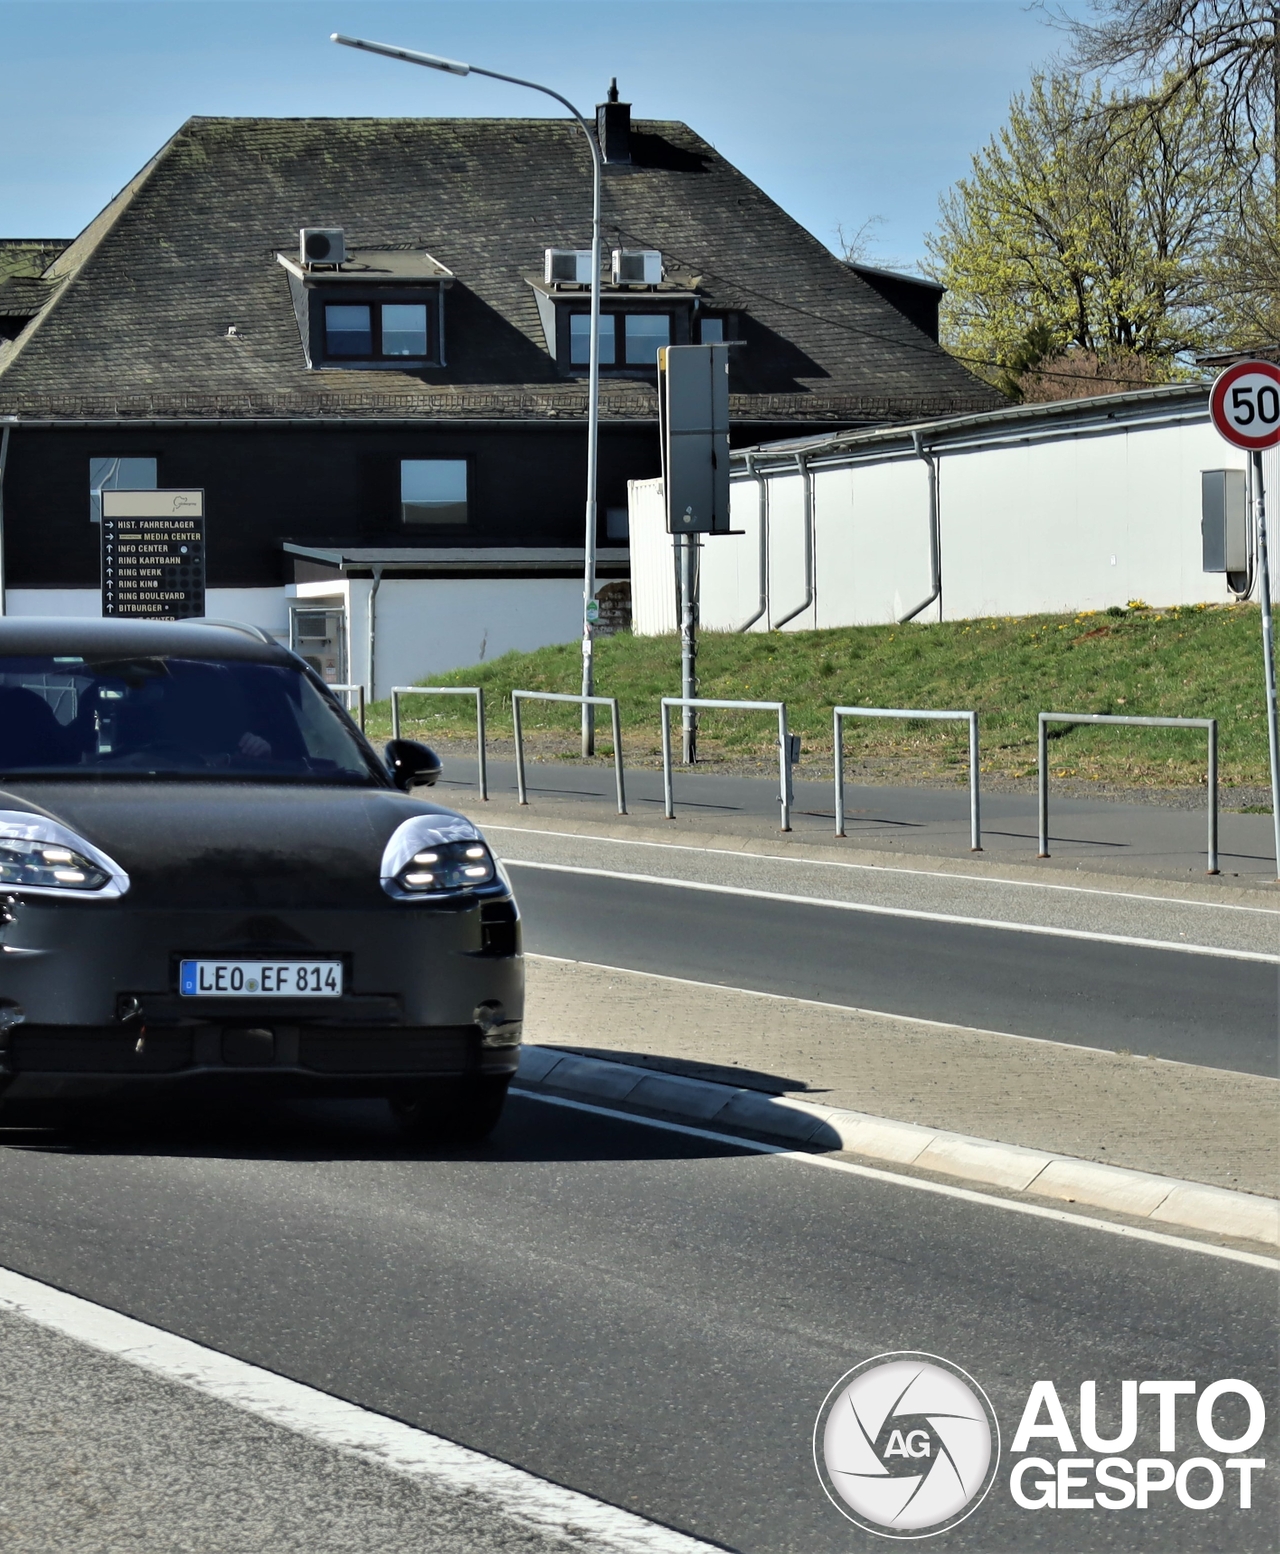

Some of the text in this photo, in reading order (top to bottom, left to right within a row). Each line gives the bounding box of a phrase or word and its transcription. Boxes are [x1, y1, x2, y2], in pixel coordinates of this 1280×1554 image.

[1232, 385, 1279, 425] 50
[117, 521, 194, 529] HIST. FAHRERLAGER
[118, 592, 185, 600] RING BOULEVARD
[118, 604, 162, 612] BITBURGER
[186, 966, 337, 991] D LEO EF 814
